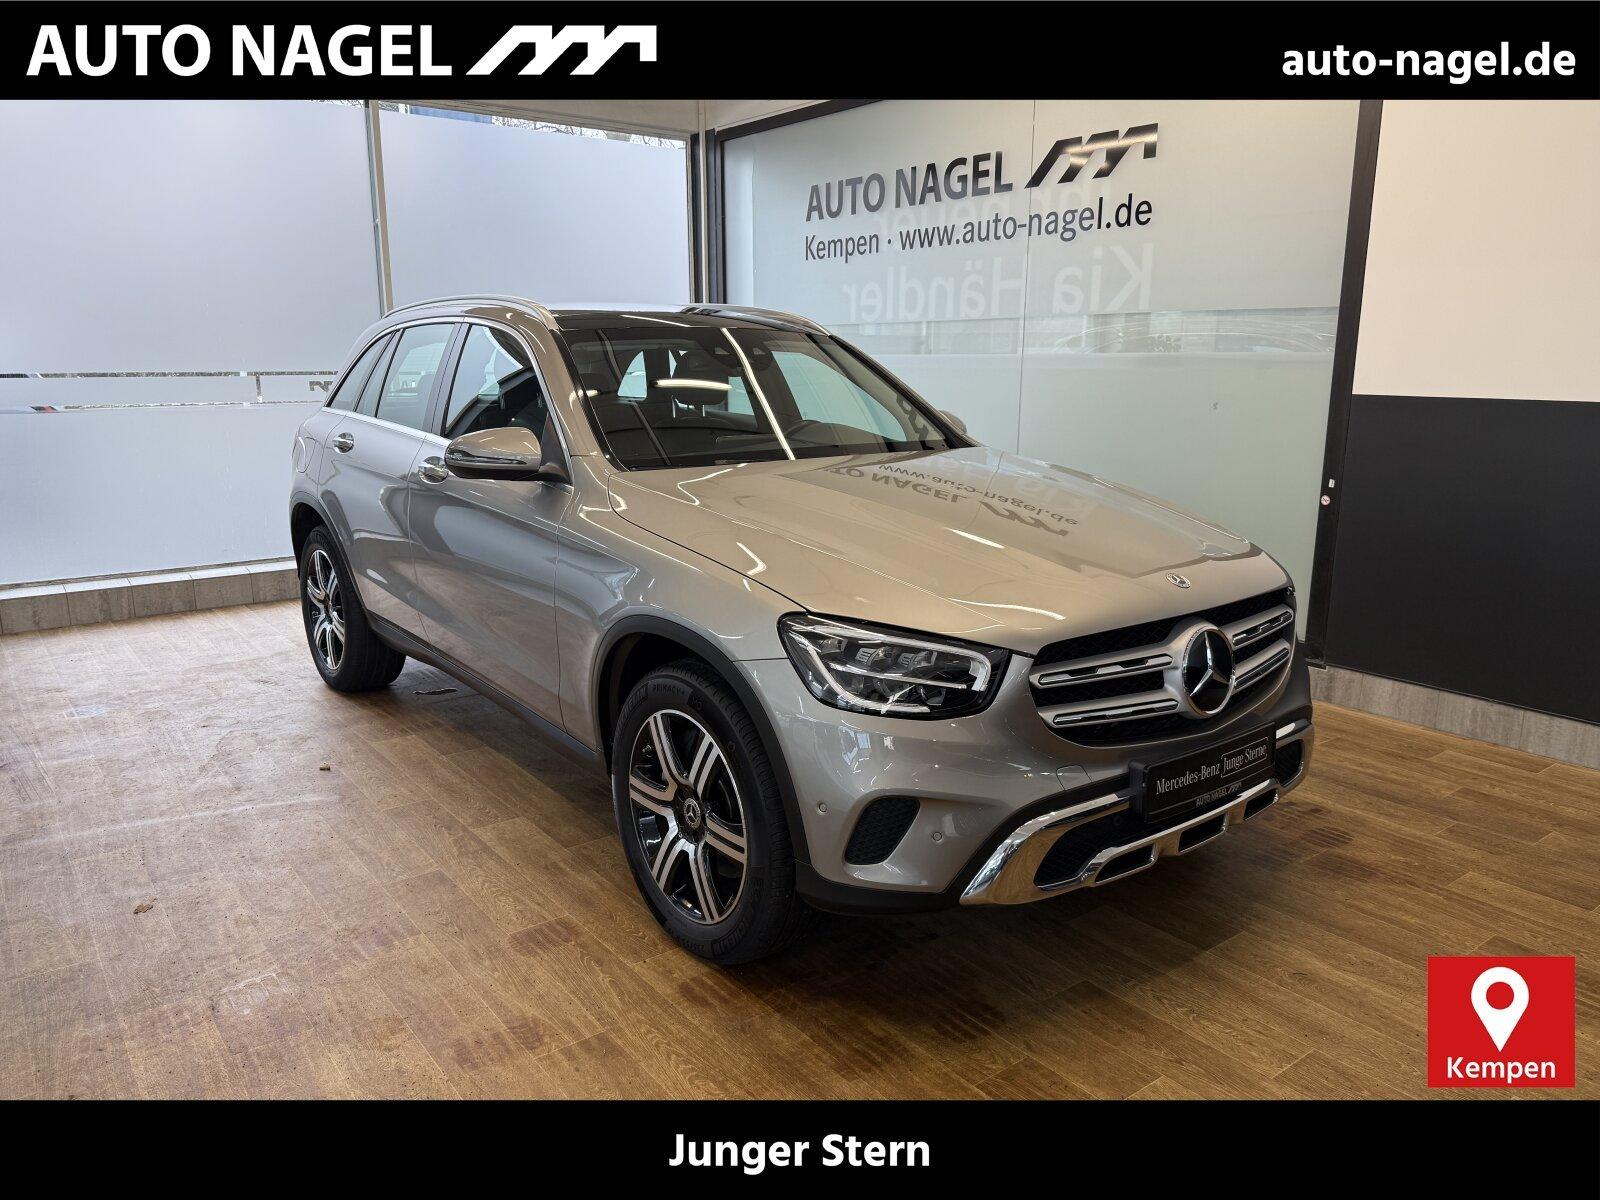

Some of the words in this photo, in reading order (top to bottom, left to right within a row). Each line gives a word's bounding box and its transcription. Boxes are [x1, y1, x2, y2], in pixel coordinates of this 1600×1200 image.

[805, 172, 886, 222] AUTO
[895, 150, 1014, 209] NAGEL
[805, 233, 880, 264] Kempen
[899, 193, 1153, 252] www.auto-nagel.de
[1155, 762, 1221, 796] Mercedes-Benz
[1222, 752, 1245, 773] Junge
[1244, 744, 1268, 763] Sterne
